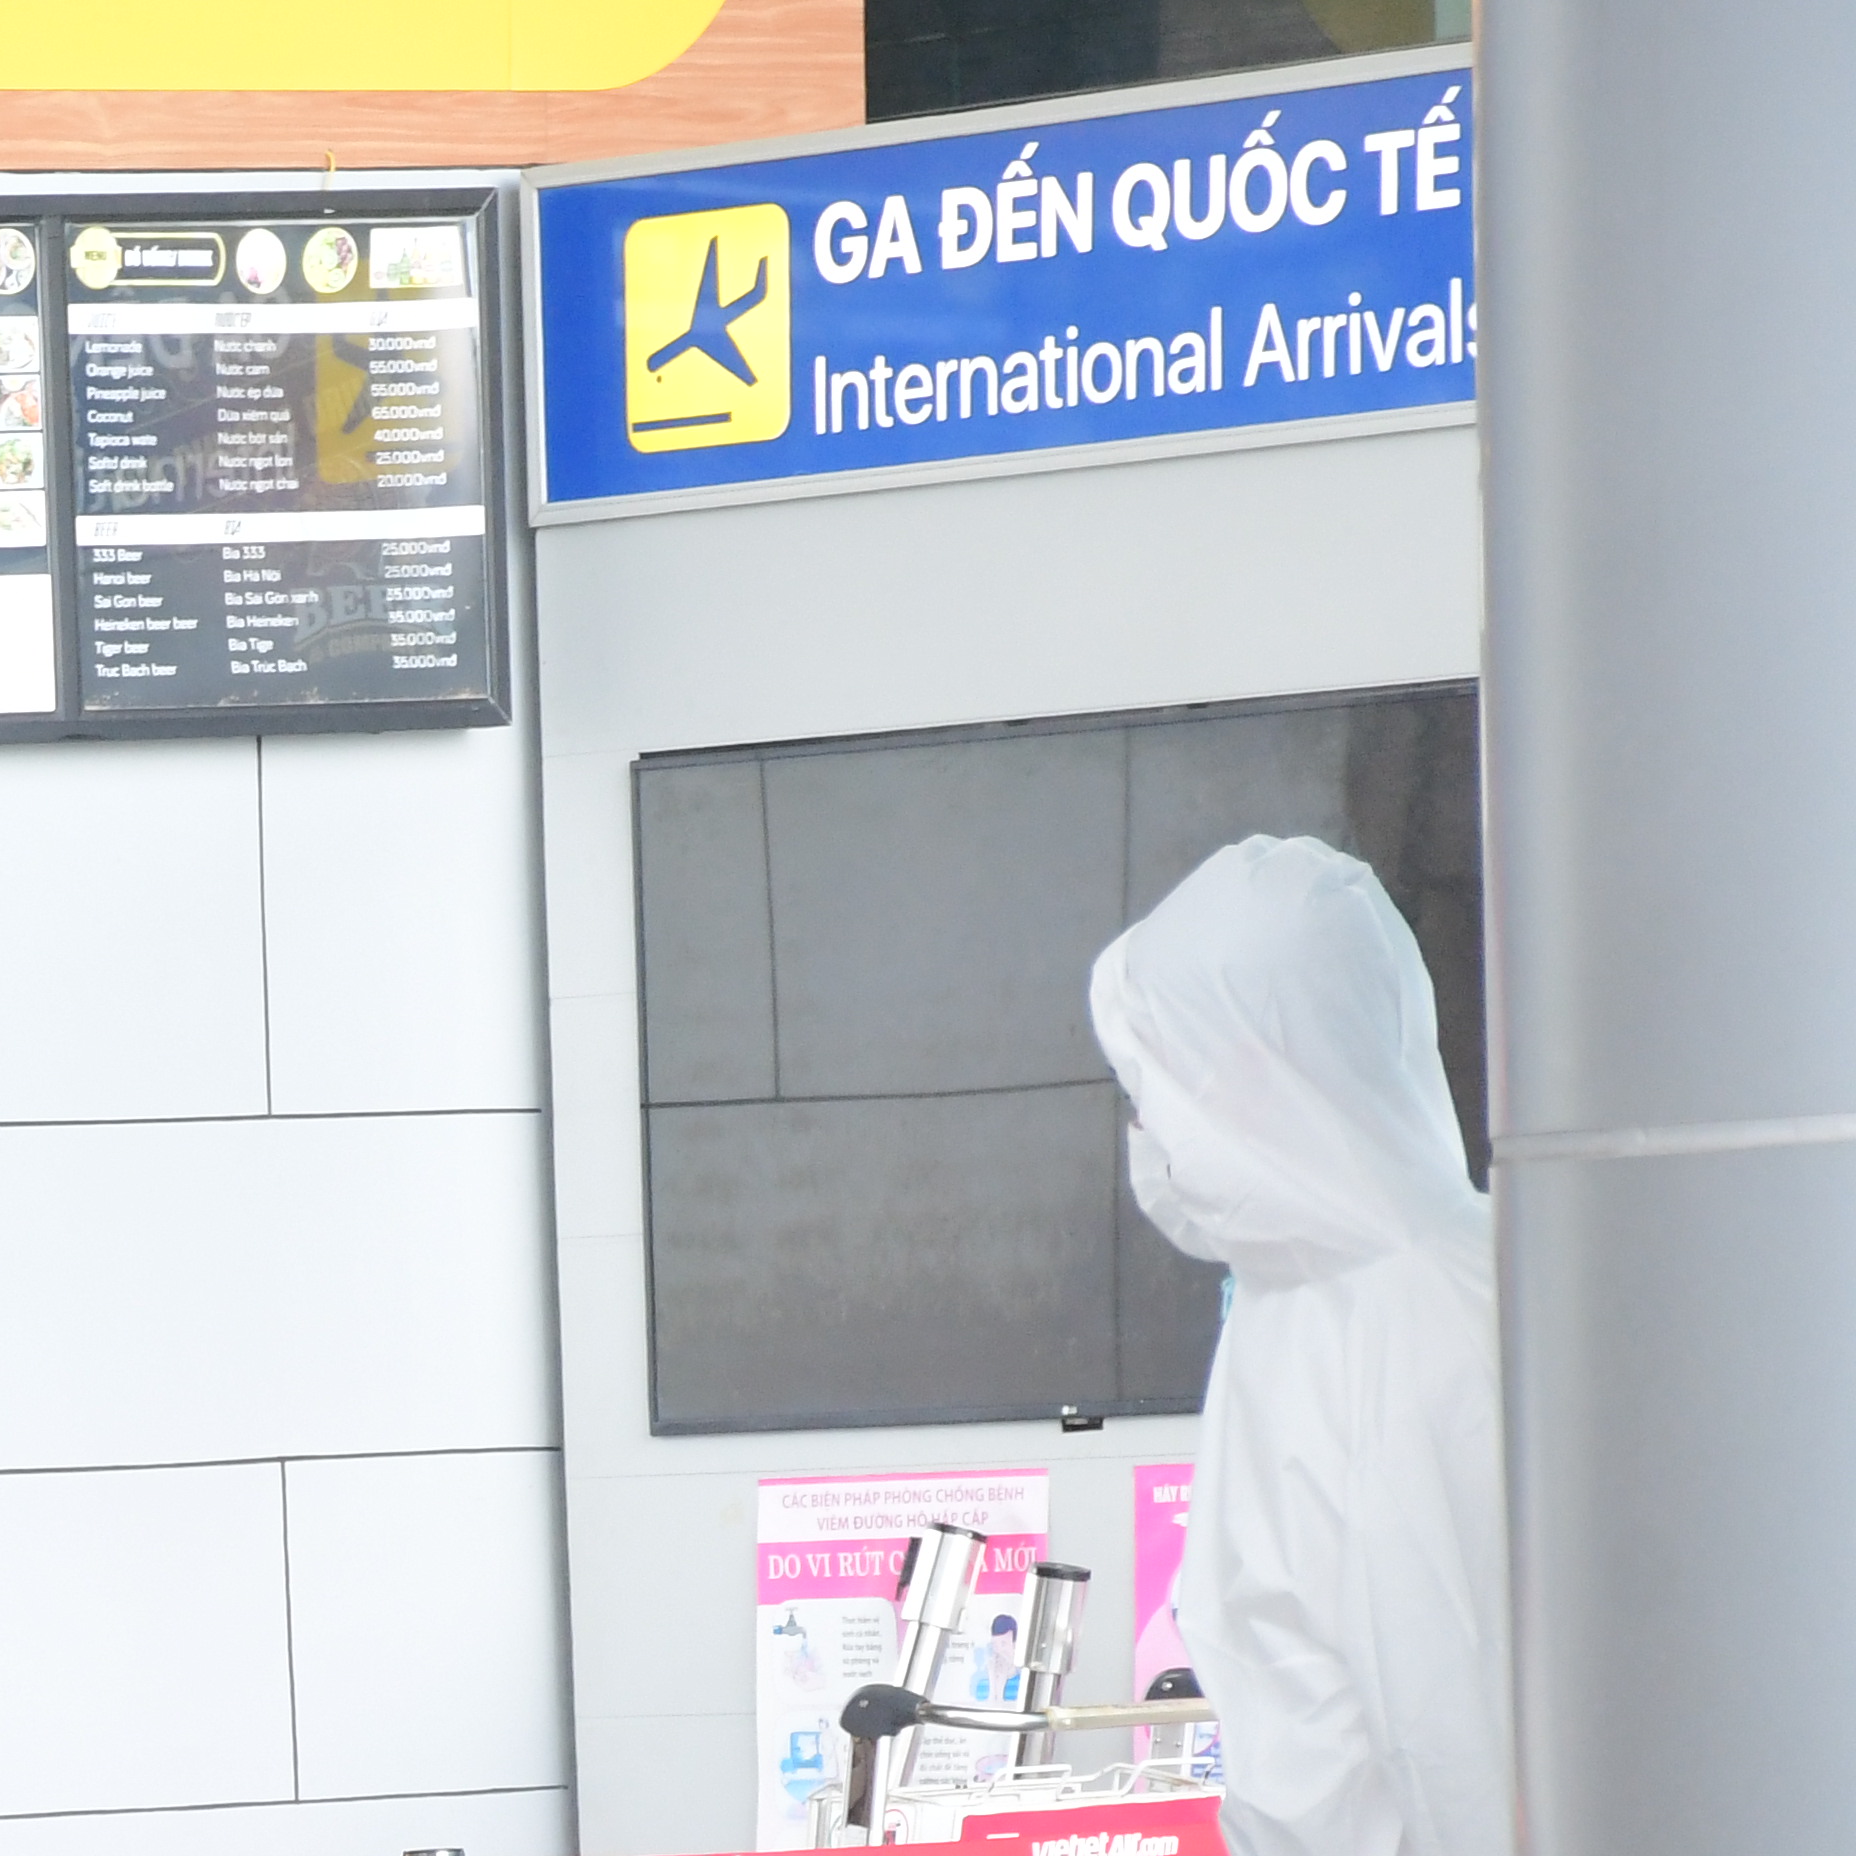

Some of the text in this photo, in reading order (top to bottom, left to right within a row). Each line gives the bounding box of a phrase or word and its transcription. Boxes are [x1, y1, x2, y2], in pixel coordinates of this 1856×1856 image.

[814, 84, 1462, 286] GA ĐẾN QUỐC TẾ
[814, 306, 1223, 436] International
[243, 545, 266, 559] 333
[768, 1554, 801, 1580] DO
[806, 1553, 831, 1578] VI
[838, 1545, 885, 1578] RÚT
